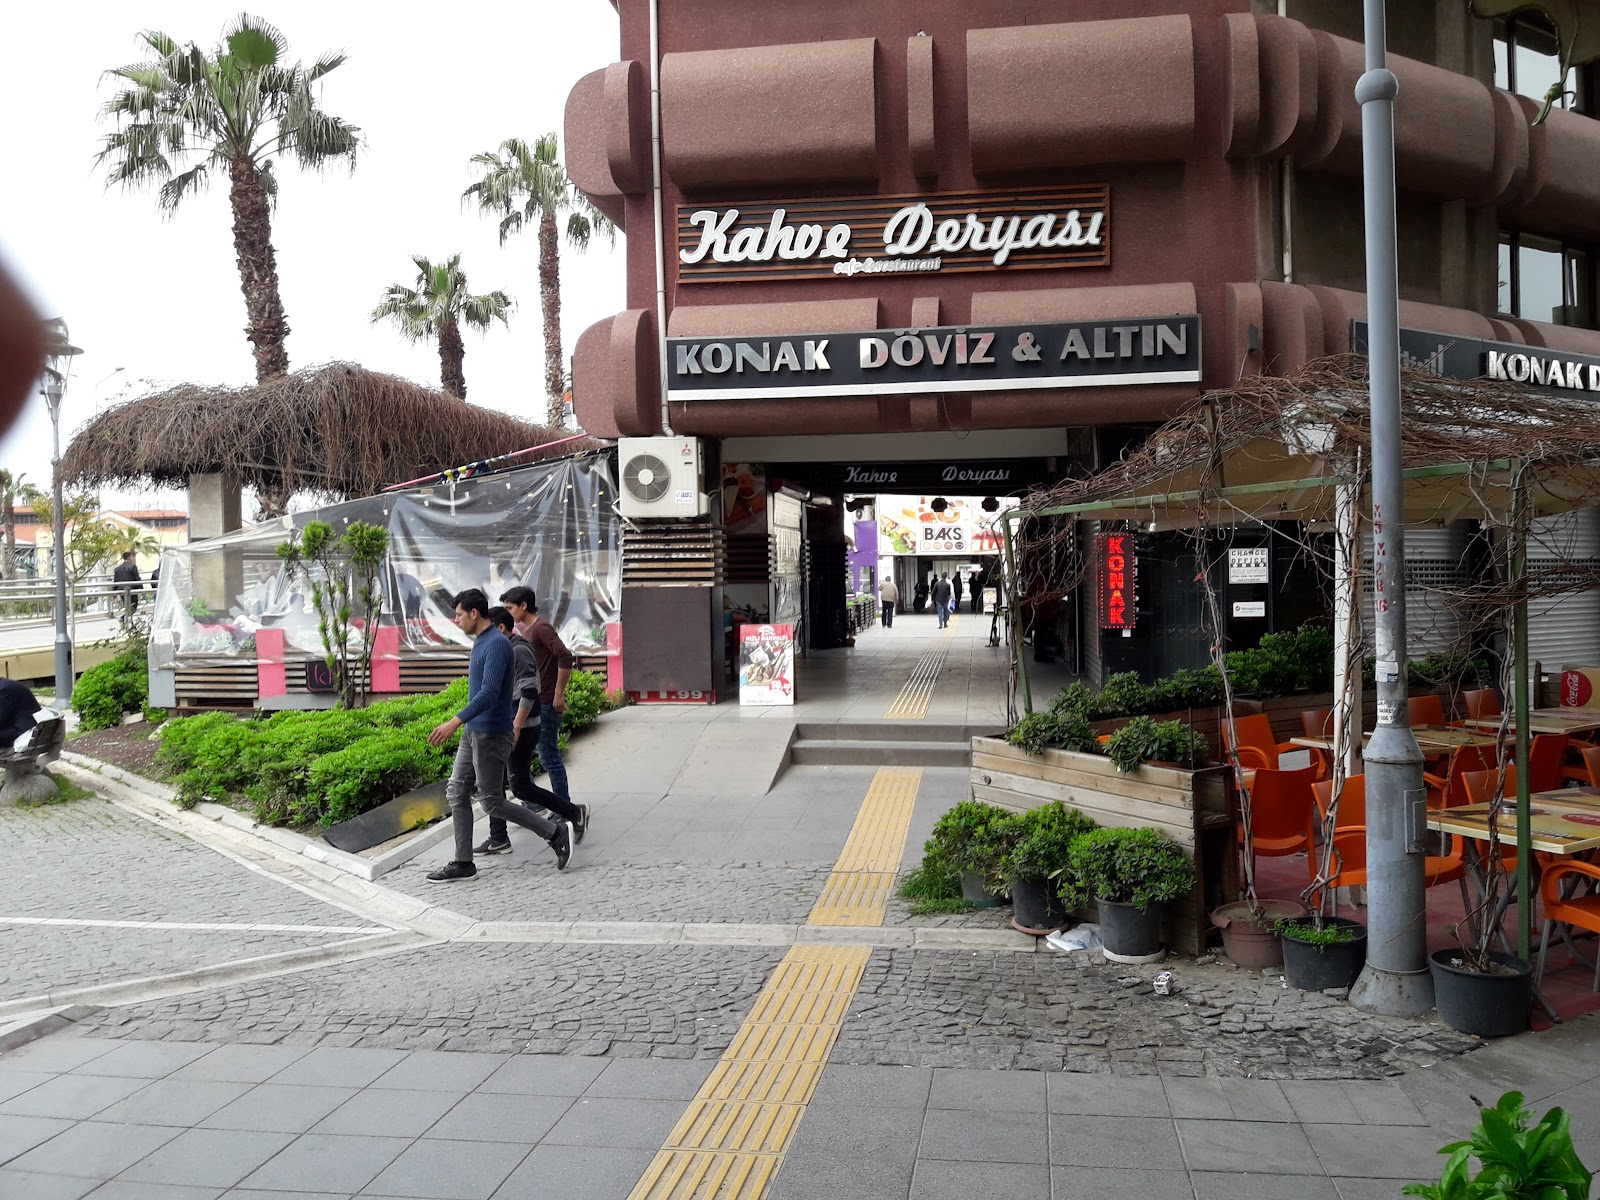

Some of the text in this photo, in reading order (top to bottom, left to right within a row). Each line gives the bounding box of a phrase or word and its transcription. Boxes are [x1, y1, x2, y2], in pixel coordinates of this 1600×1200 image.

[680, 202, 1104, 266] Kahve Deryası
[676, 323, 1187, 375] KONAK DÖVİZ & ALTIN
[1488, 350, 1585, 390] KONAK
[844, 466, 898, 483] Kahve
[924, 527, 963, 541] BAKS
[1108, 536, 1126, 625] KONAK
